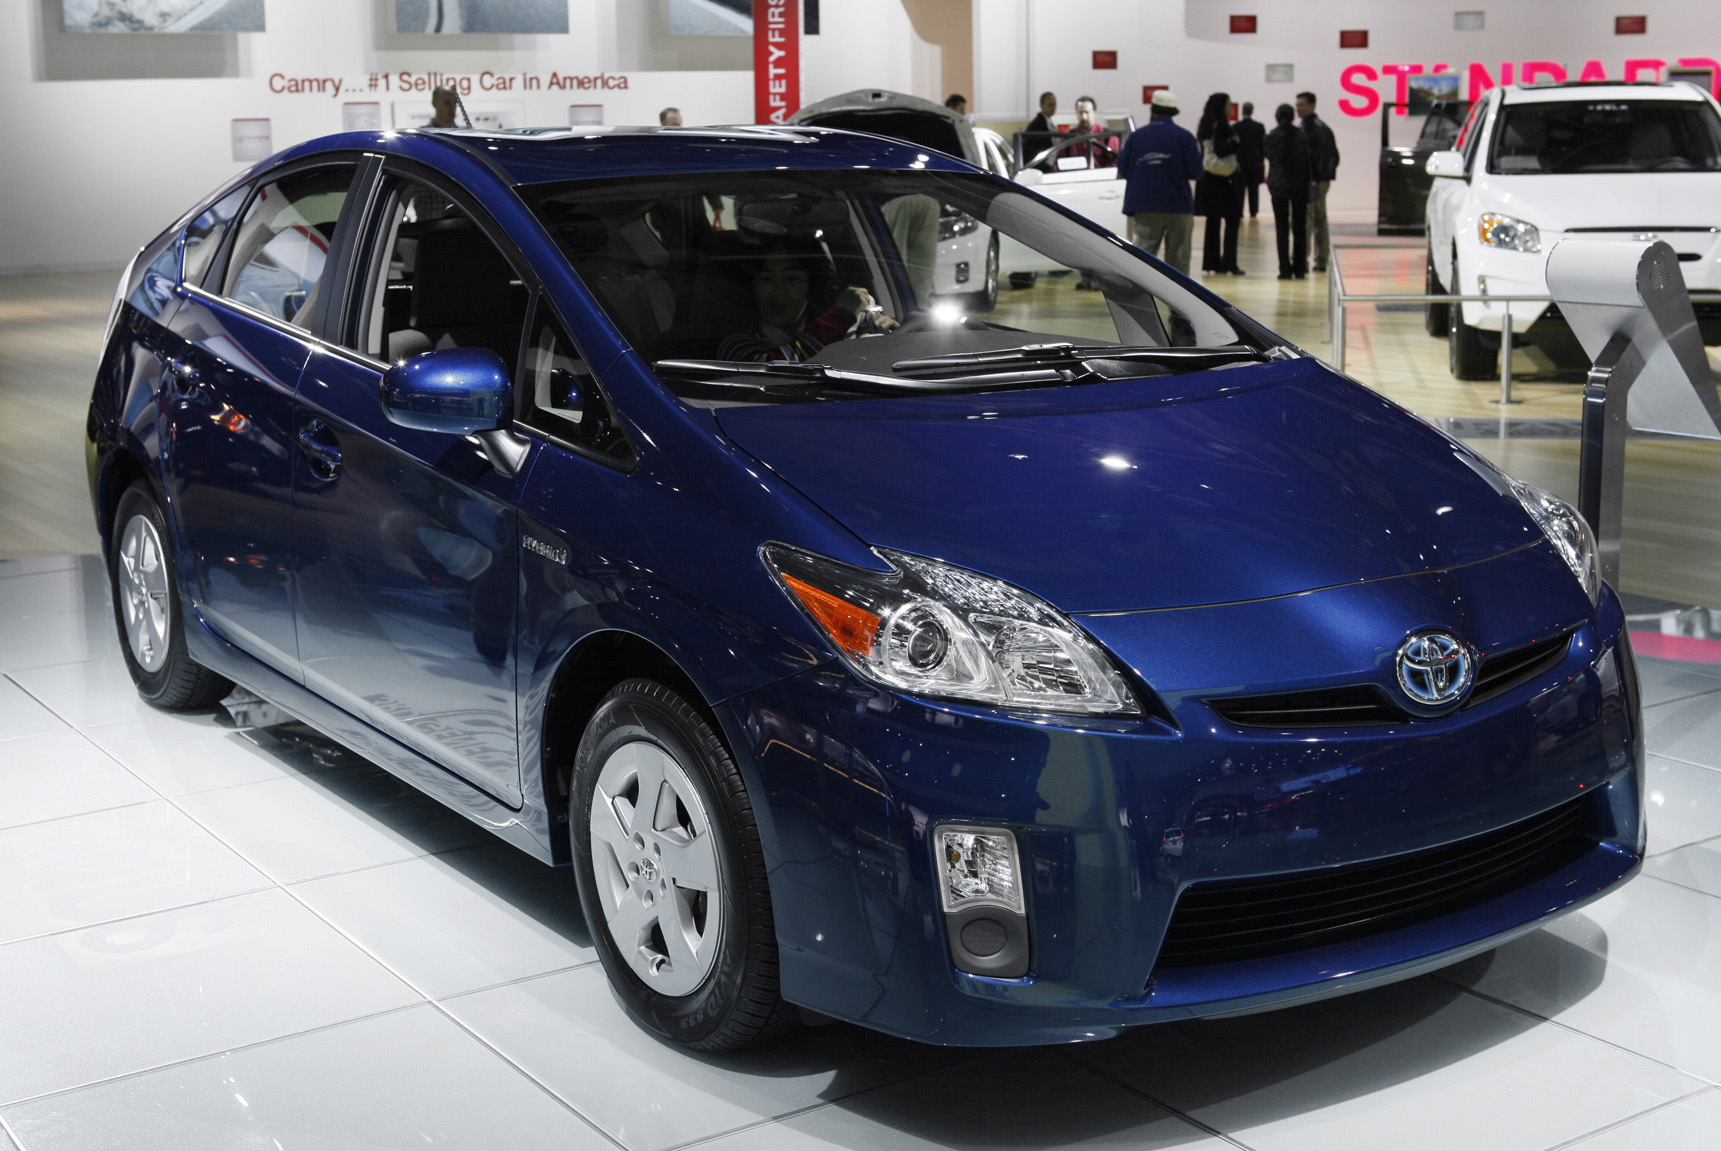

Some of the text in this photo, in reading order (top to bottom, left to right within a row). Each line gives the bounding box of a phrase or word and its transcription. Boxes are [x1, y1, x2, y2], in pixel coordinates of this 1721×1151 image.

[368, 73, 391, 92] #1
[398, 72, 472, 96] Selling
[479, 71, 516, 91] Car
[522, 72, 540, 90] in
[547, 71, 629, 90] America
